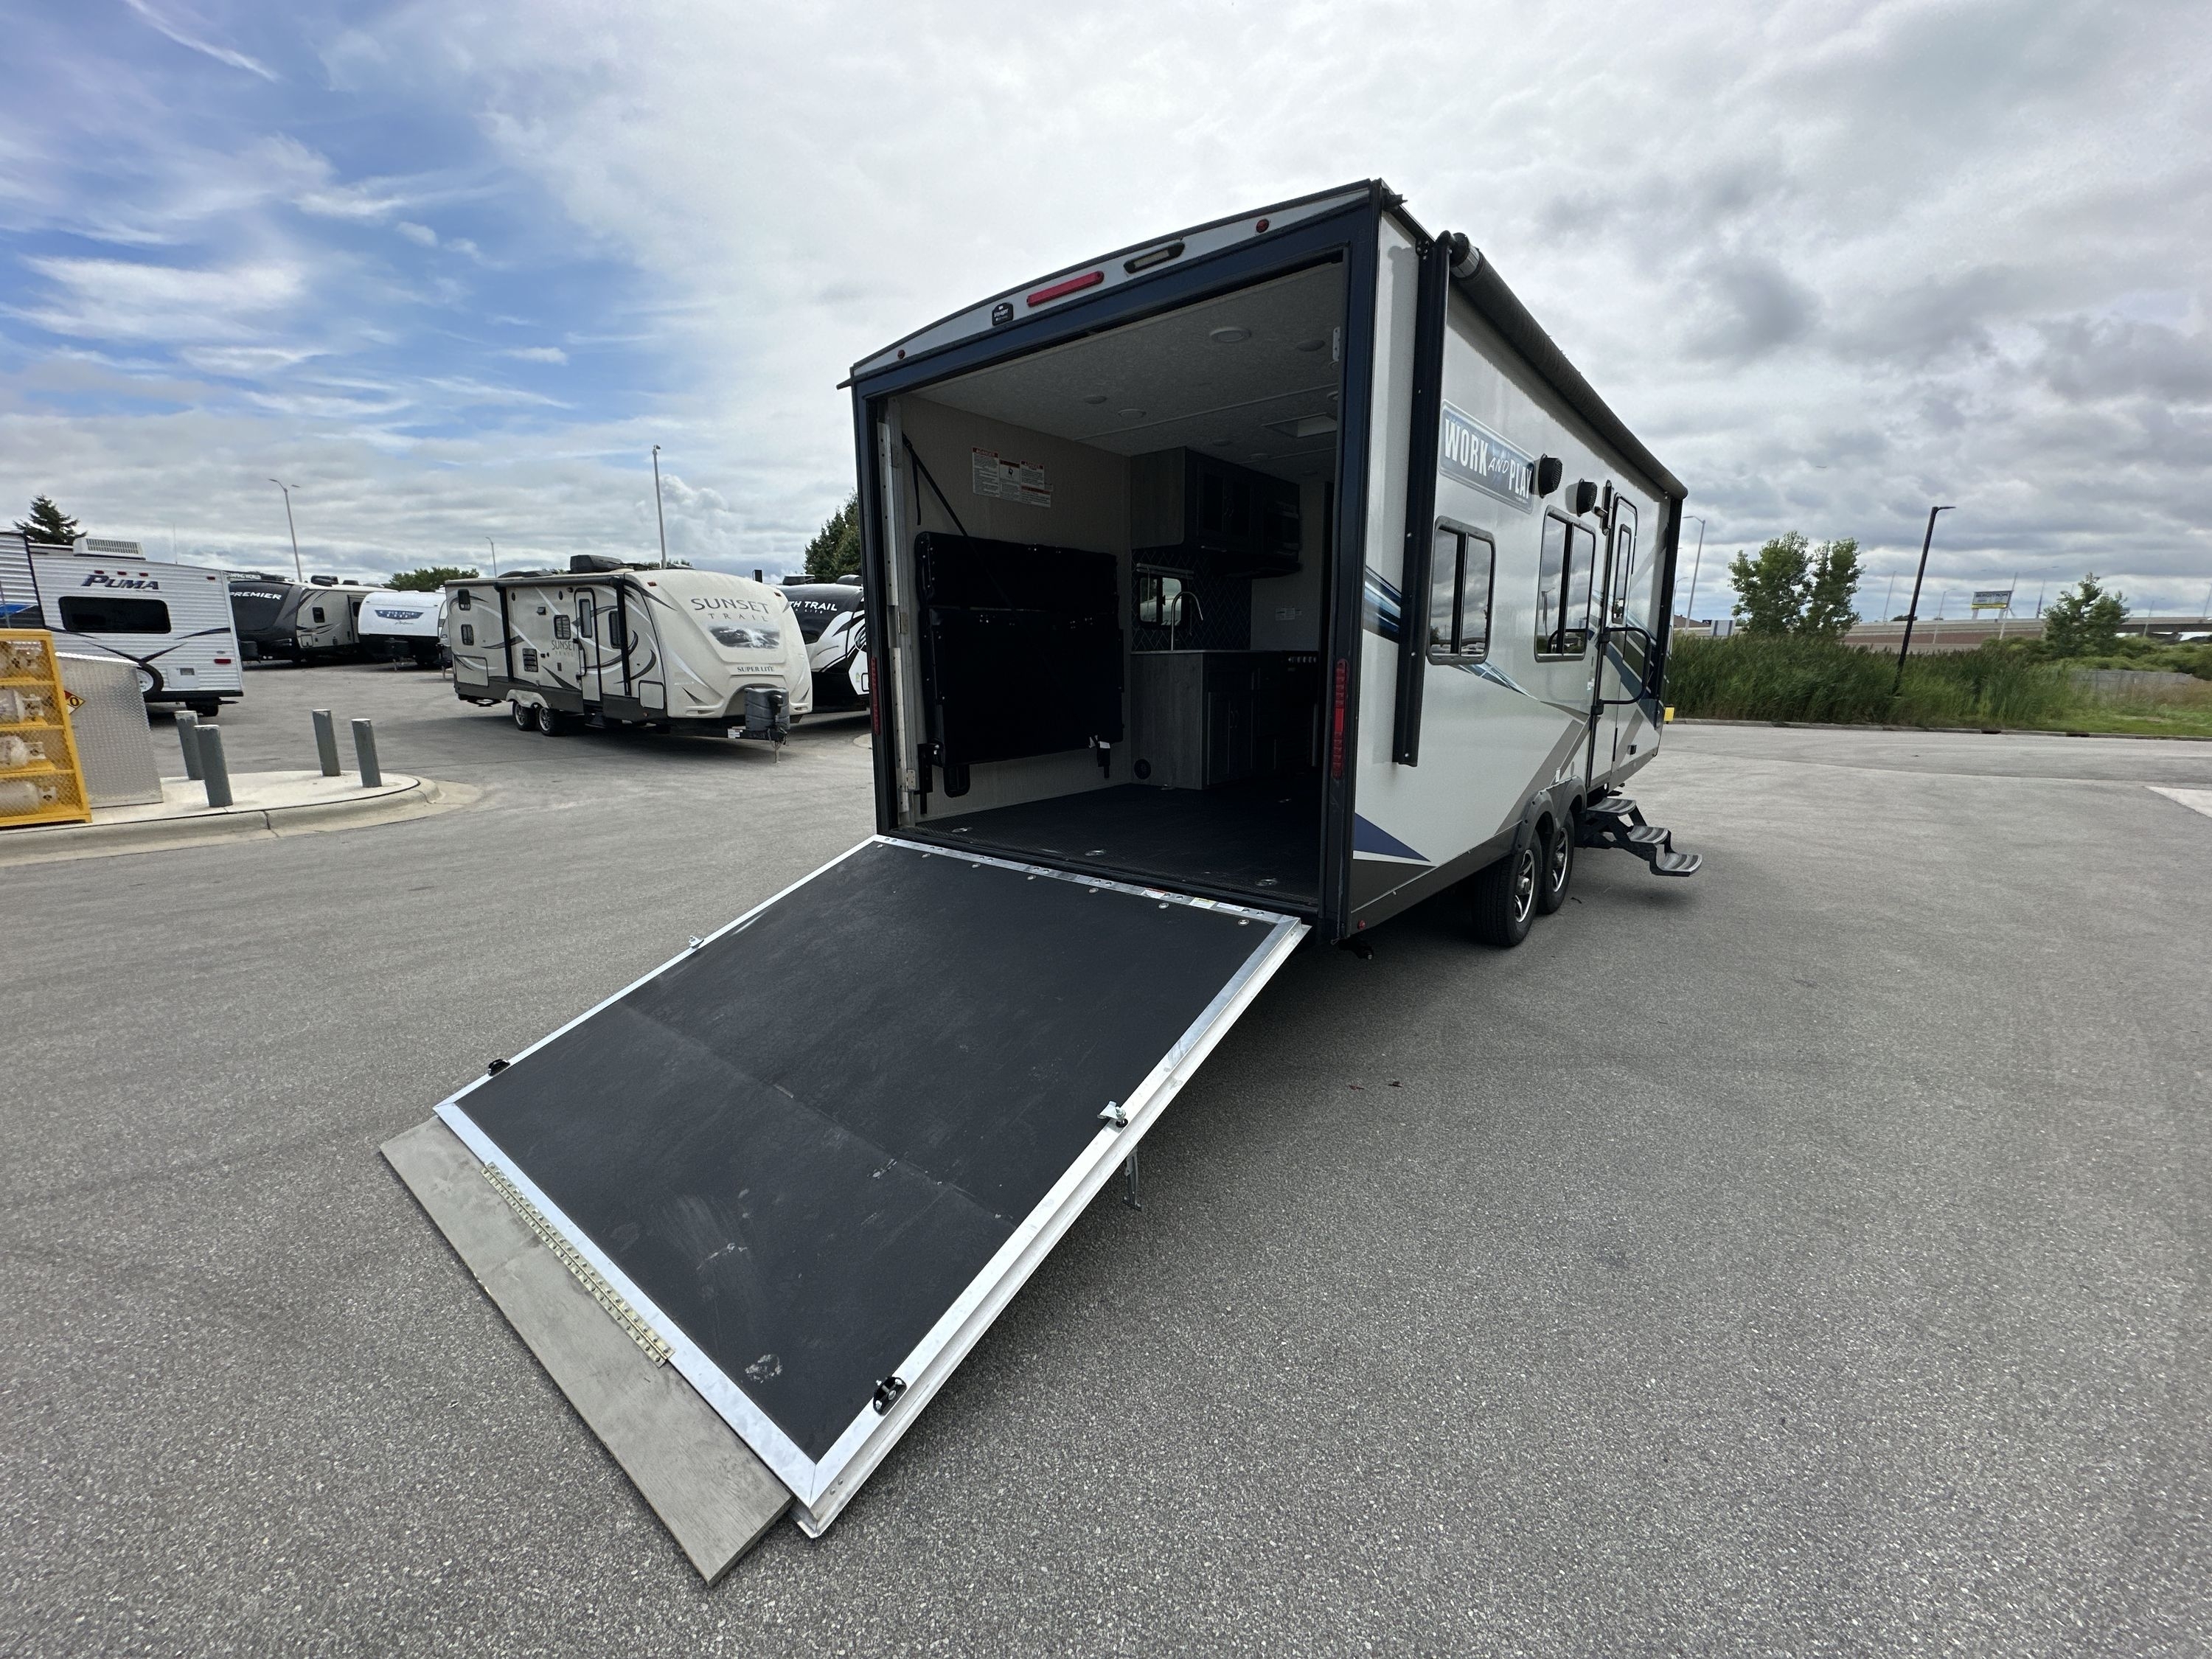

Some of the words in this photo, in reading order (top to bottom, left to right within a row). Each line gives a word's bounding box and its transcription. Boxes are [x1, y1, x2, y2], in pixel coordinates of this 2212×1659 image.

[1444, 418, 1489, 477] WORK
[1487, 457, 1510, 474] AND
[1508, 459, 1532, 499] PLAY
[80, 574, 160, 590] PUMA
[229, 591, 282, 600] PREMIER
[690, 598, 769, 614] SUNSET
[804, 601, 838, 611] TRAIL
[708, 613, 768, 622] TRAIL
[551, 639, 576, 651] SUNSET
